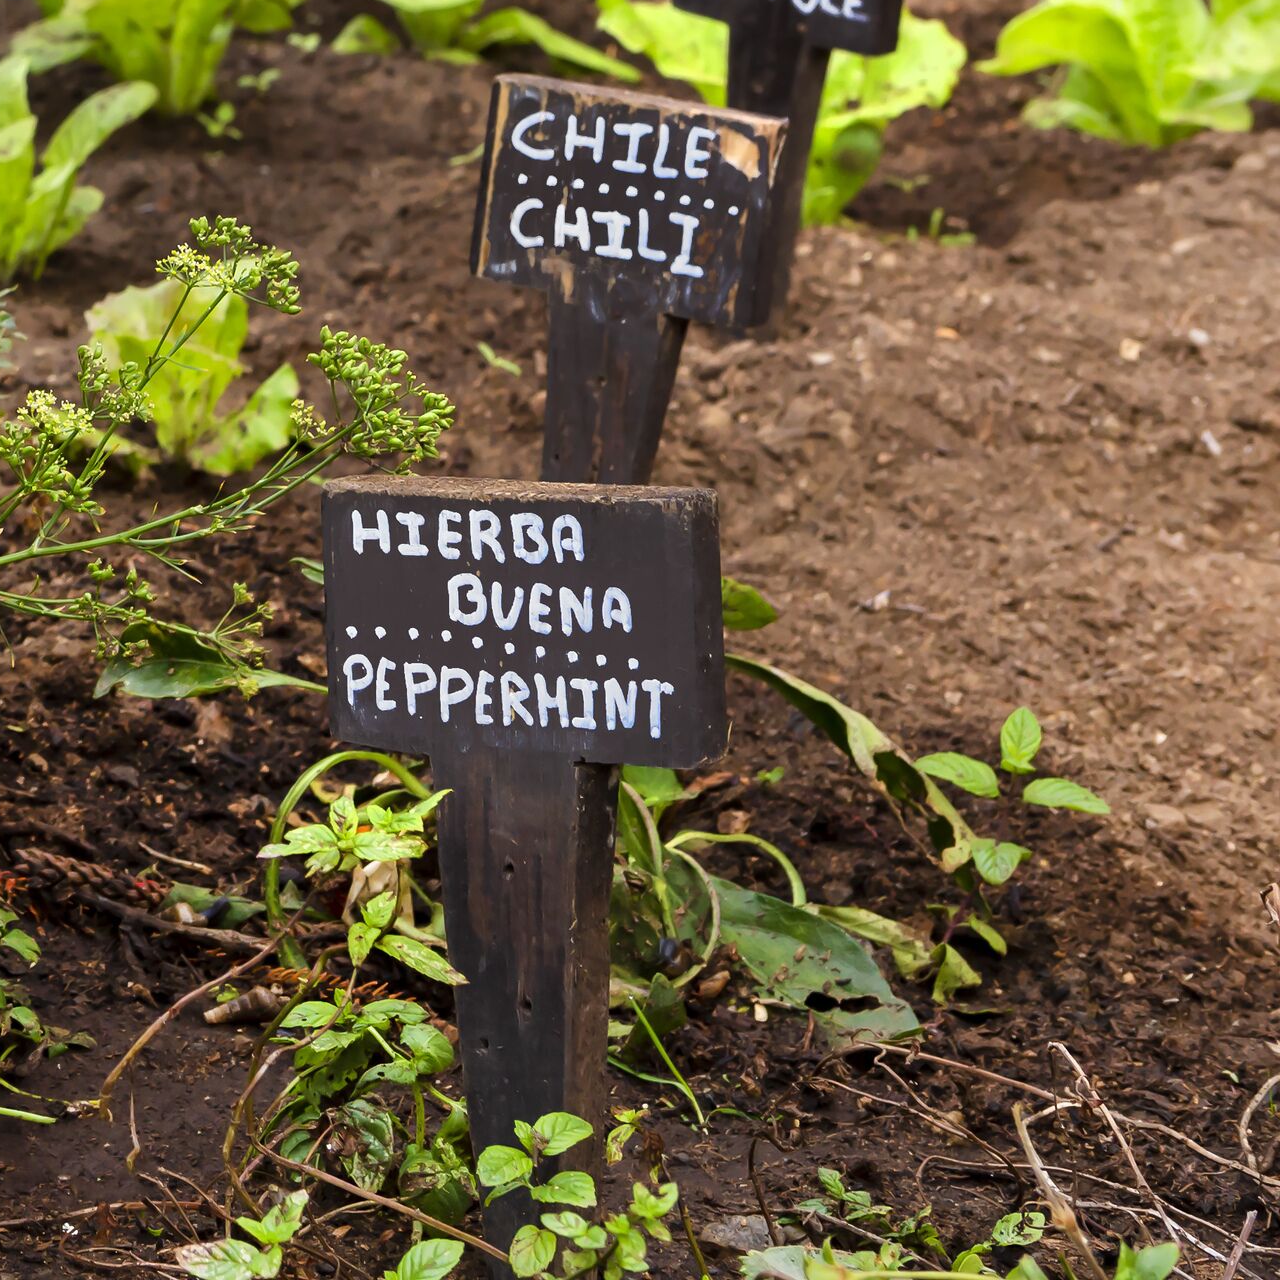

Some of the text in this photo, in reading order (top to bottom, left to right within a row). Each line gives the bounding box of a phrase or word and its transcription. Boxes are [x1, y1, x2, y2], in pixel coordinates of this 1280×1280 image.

[511, 111, 716, 179] CHILE
[509, 197, 704, 279] CHILI
[351, 509, 586, 564] HIERBA
[447, 572, 633, 637] BUENA
